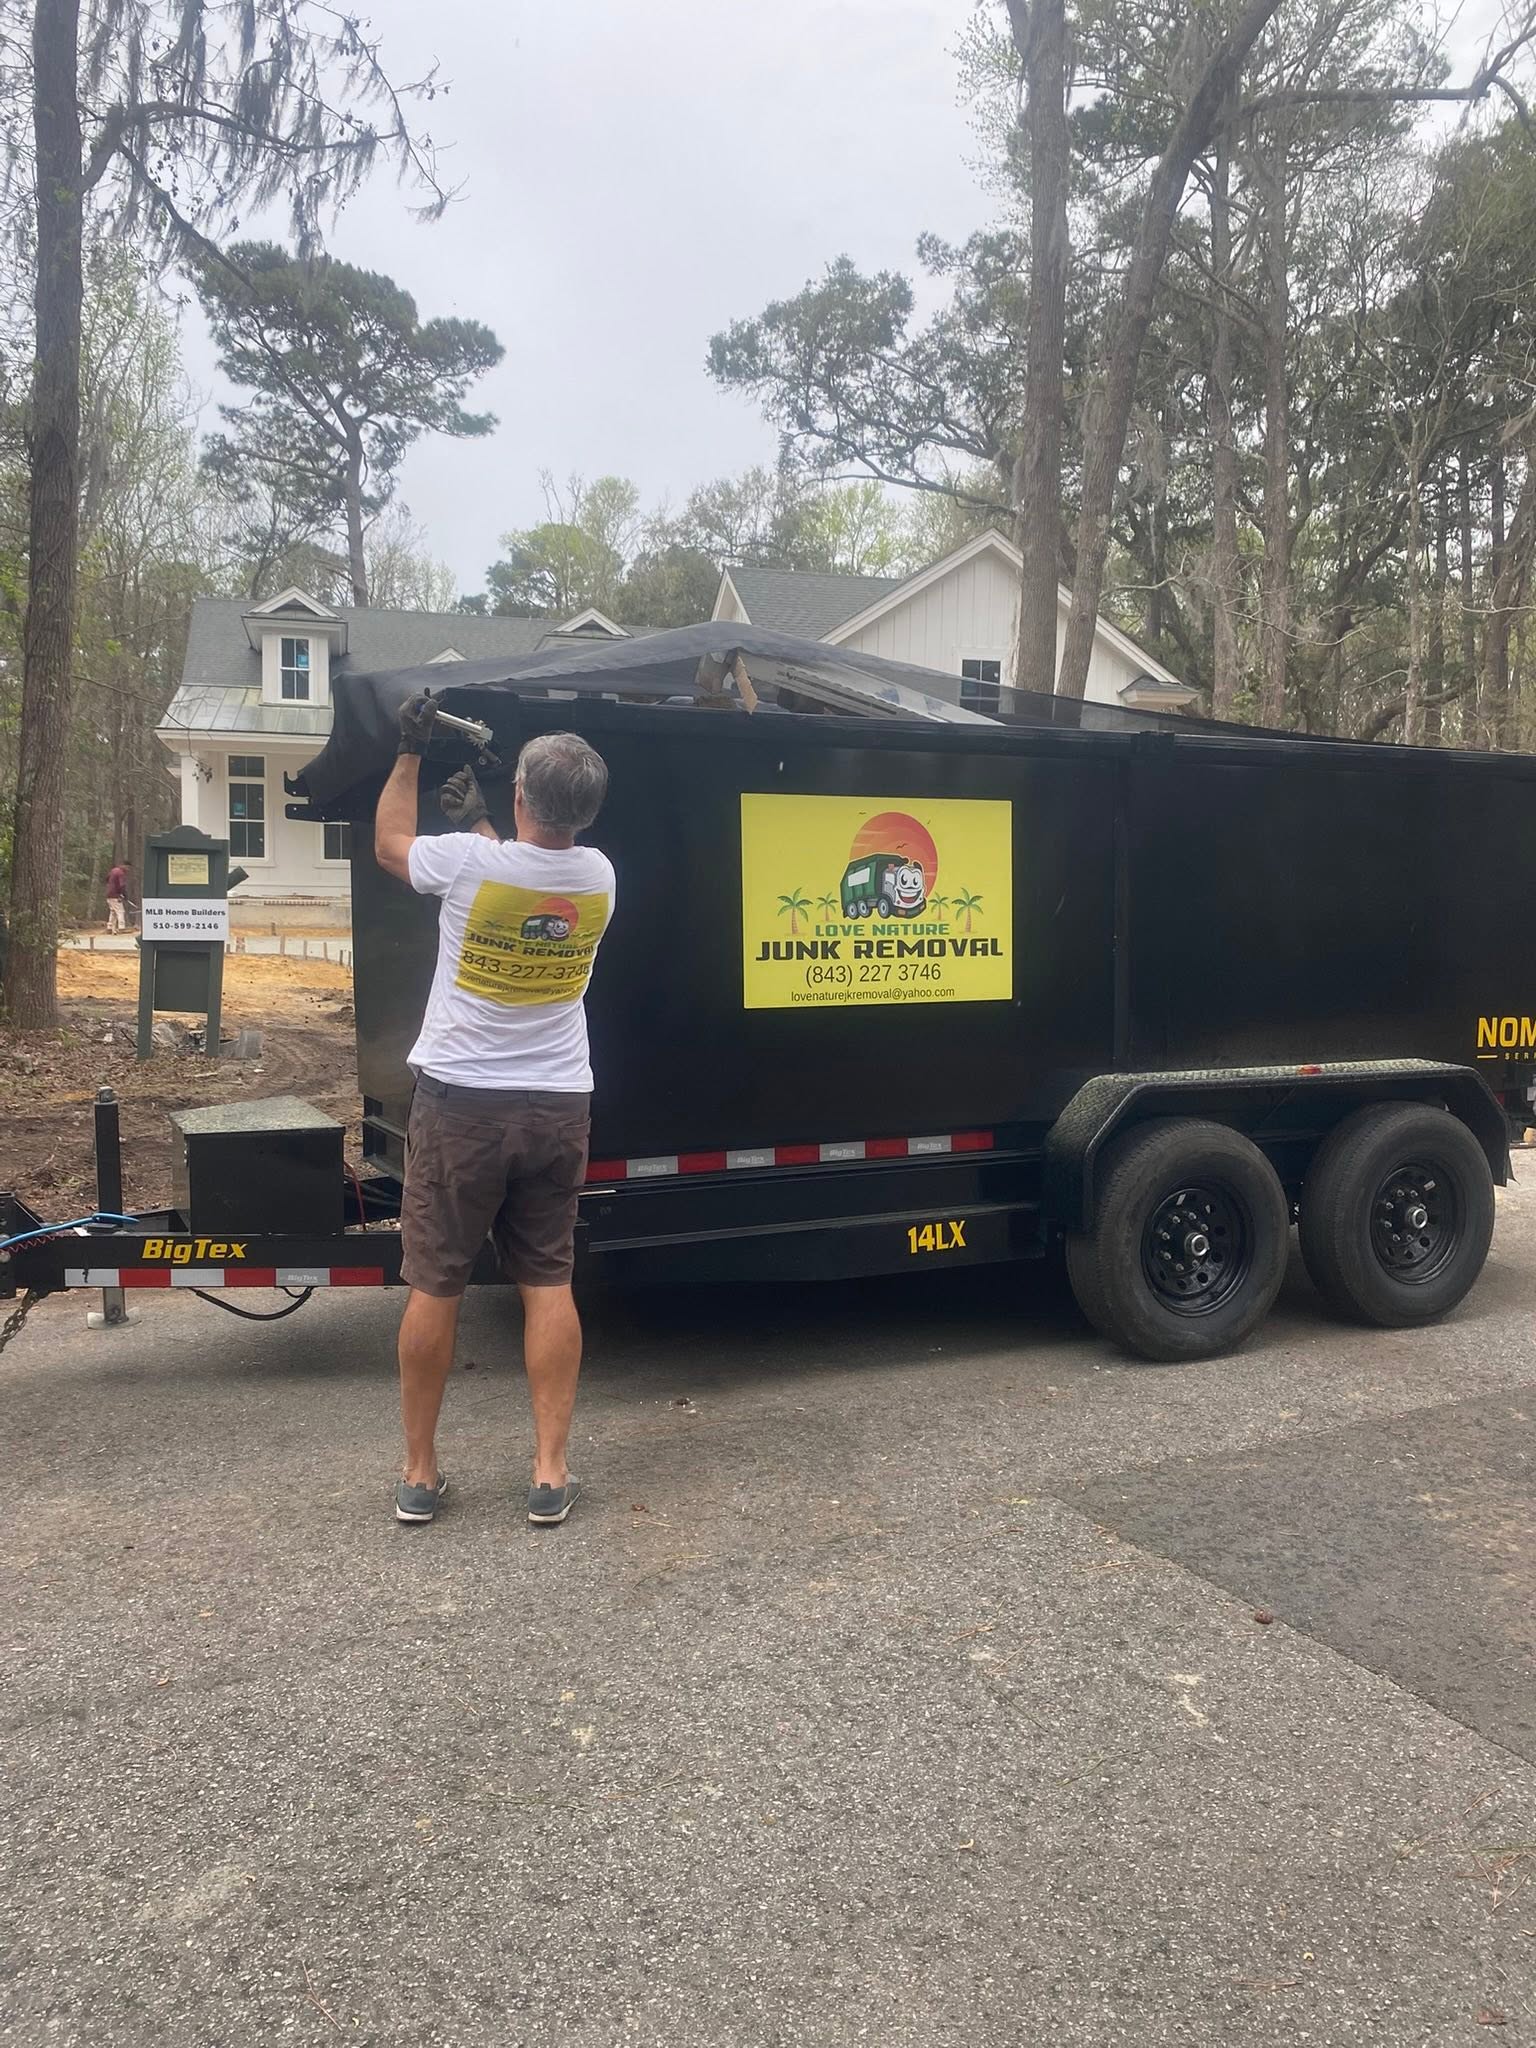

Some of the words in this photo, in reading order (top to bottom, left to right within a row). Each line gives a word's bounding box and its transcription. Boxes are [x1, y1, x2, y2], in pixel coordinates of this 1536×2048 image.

[145, 908, 163, 916] MLB
[191, 908, 226, 916] Builders
[153, 922, 219, 930] 510-599-2146
[815, 924, 865, 937] LOVE
[872, 923, 950, 936] NATURE
[466, 932, 517, 952] JUNK
[755, 940, 841, 961] JUNK
[853, 938, 1004, 960] REMOVAL
[805, 964, 853, 988] (843)
[859, 964, 892, 982] 227
[898, 963, 942, 981] 3746
[791, 988, 955, 1003] lovenaturejkremoval@yahoo.com
[907, 1219, 966, 1255] 14LX
[142, 1239, 248, 1265] BigTex
